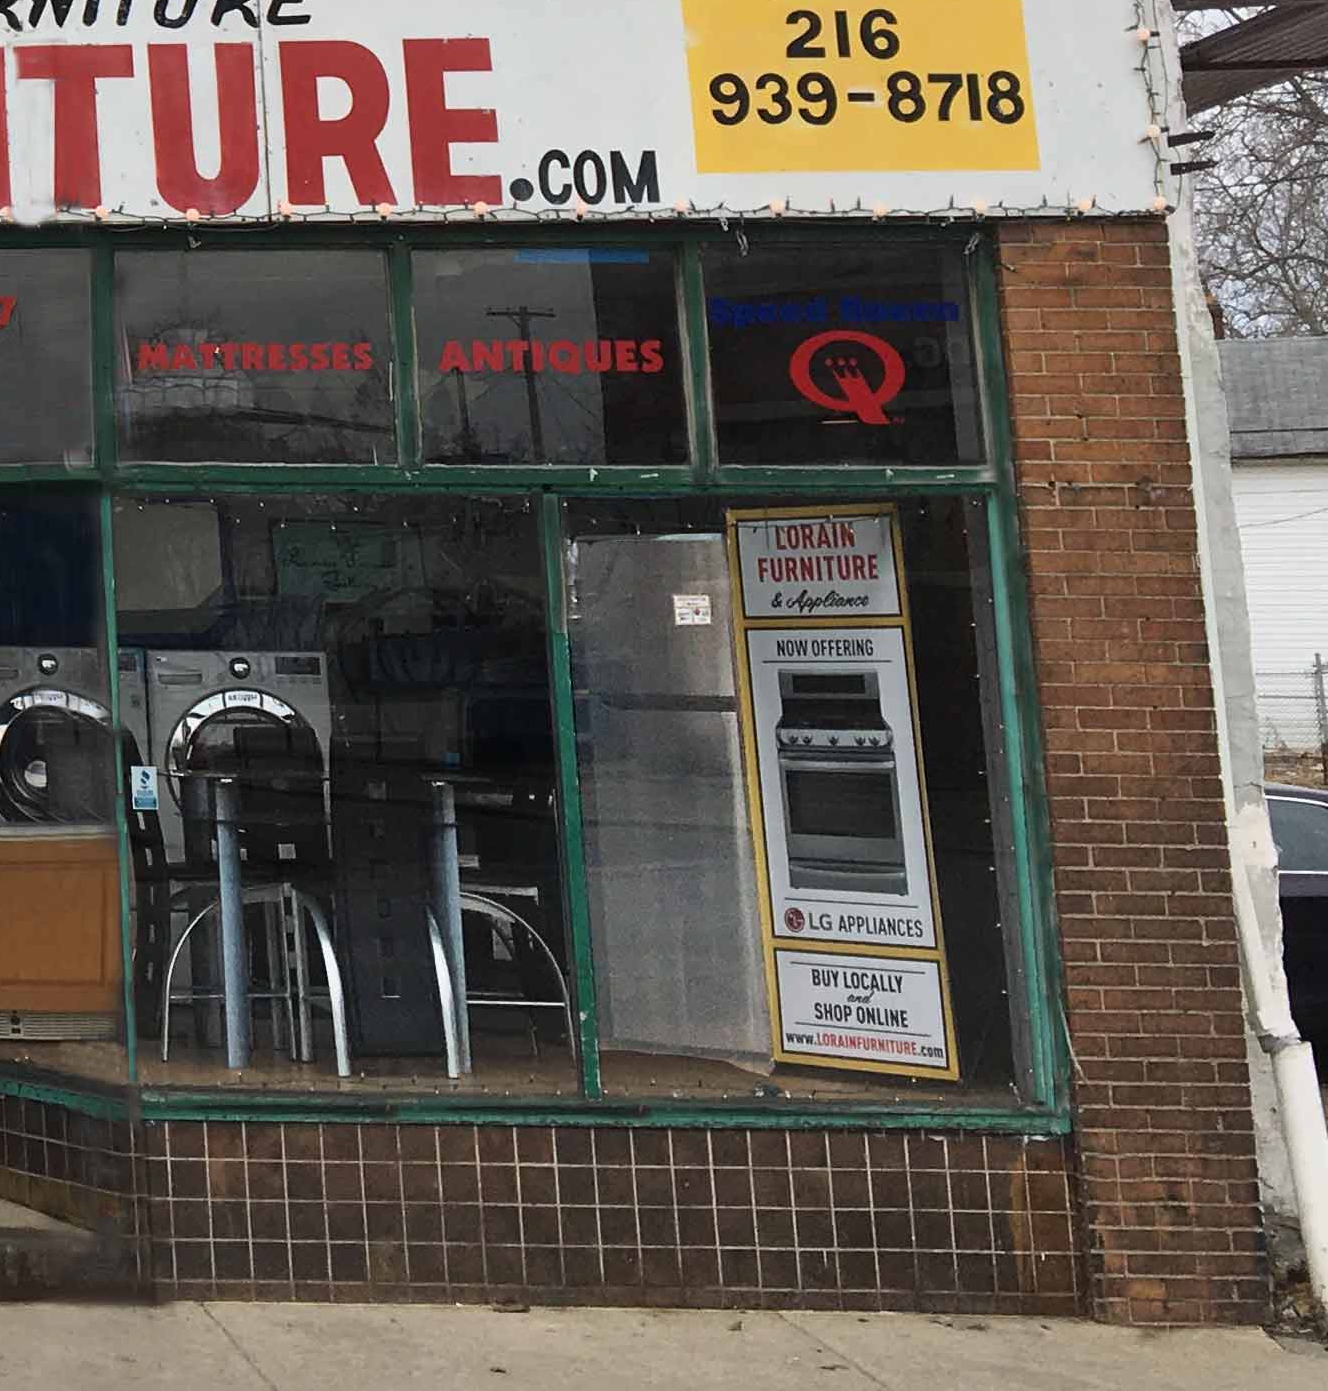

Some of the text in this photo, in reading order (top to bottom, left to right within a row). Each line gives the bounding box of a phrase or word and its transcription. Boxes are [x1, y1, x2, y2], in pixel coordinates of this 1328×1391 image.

[786, 9, 900, 59] 216
[709, 70, 1025, 126] 939-8718
[137, 341, 374, 371] MATTRESSES
[438, 339, 664, 374] ANTIQUES
[774, 522, 856, 550] LORAIN
[757, 553, 879, 583] FURNITURE
[771, 589, 870, 614] & Appliance
[776, 638, 874, 658] NOW OFFERING
[808, 912, 924, 938] LG APPLIANCES
[811, 969, 904, 994] BUY LOCALLY
[847, 991, 875, 1004] and
[814, 1003, 909, 1029] SHOP ONLINE
